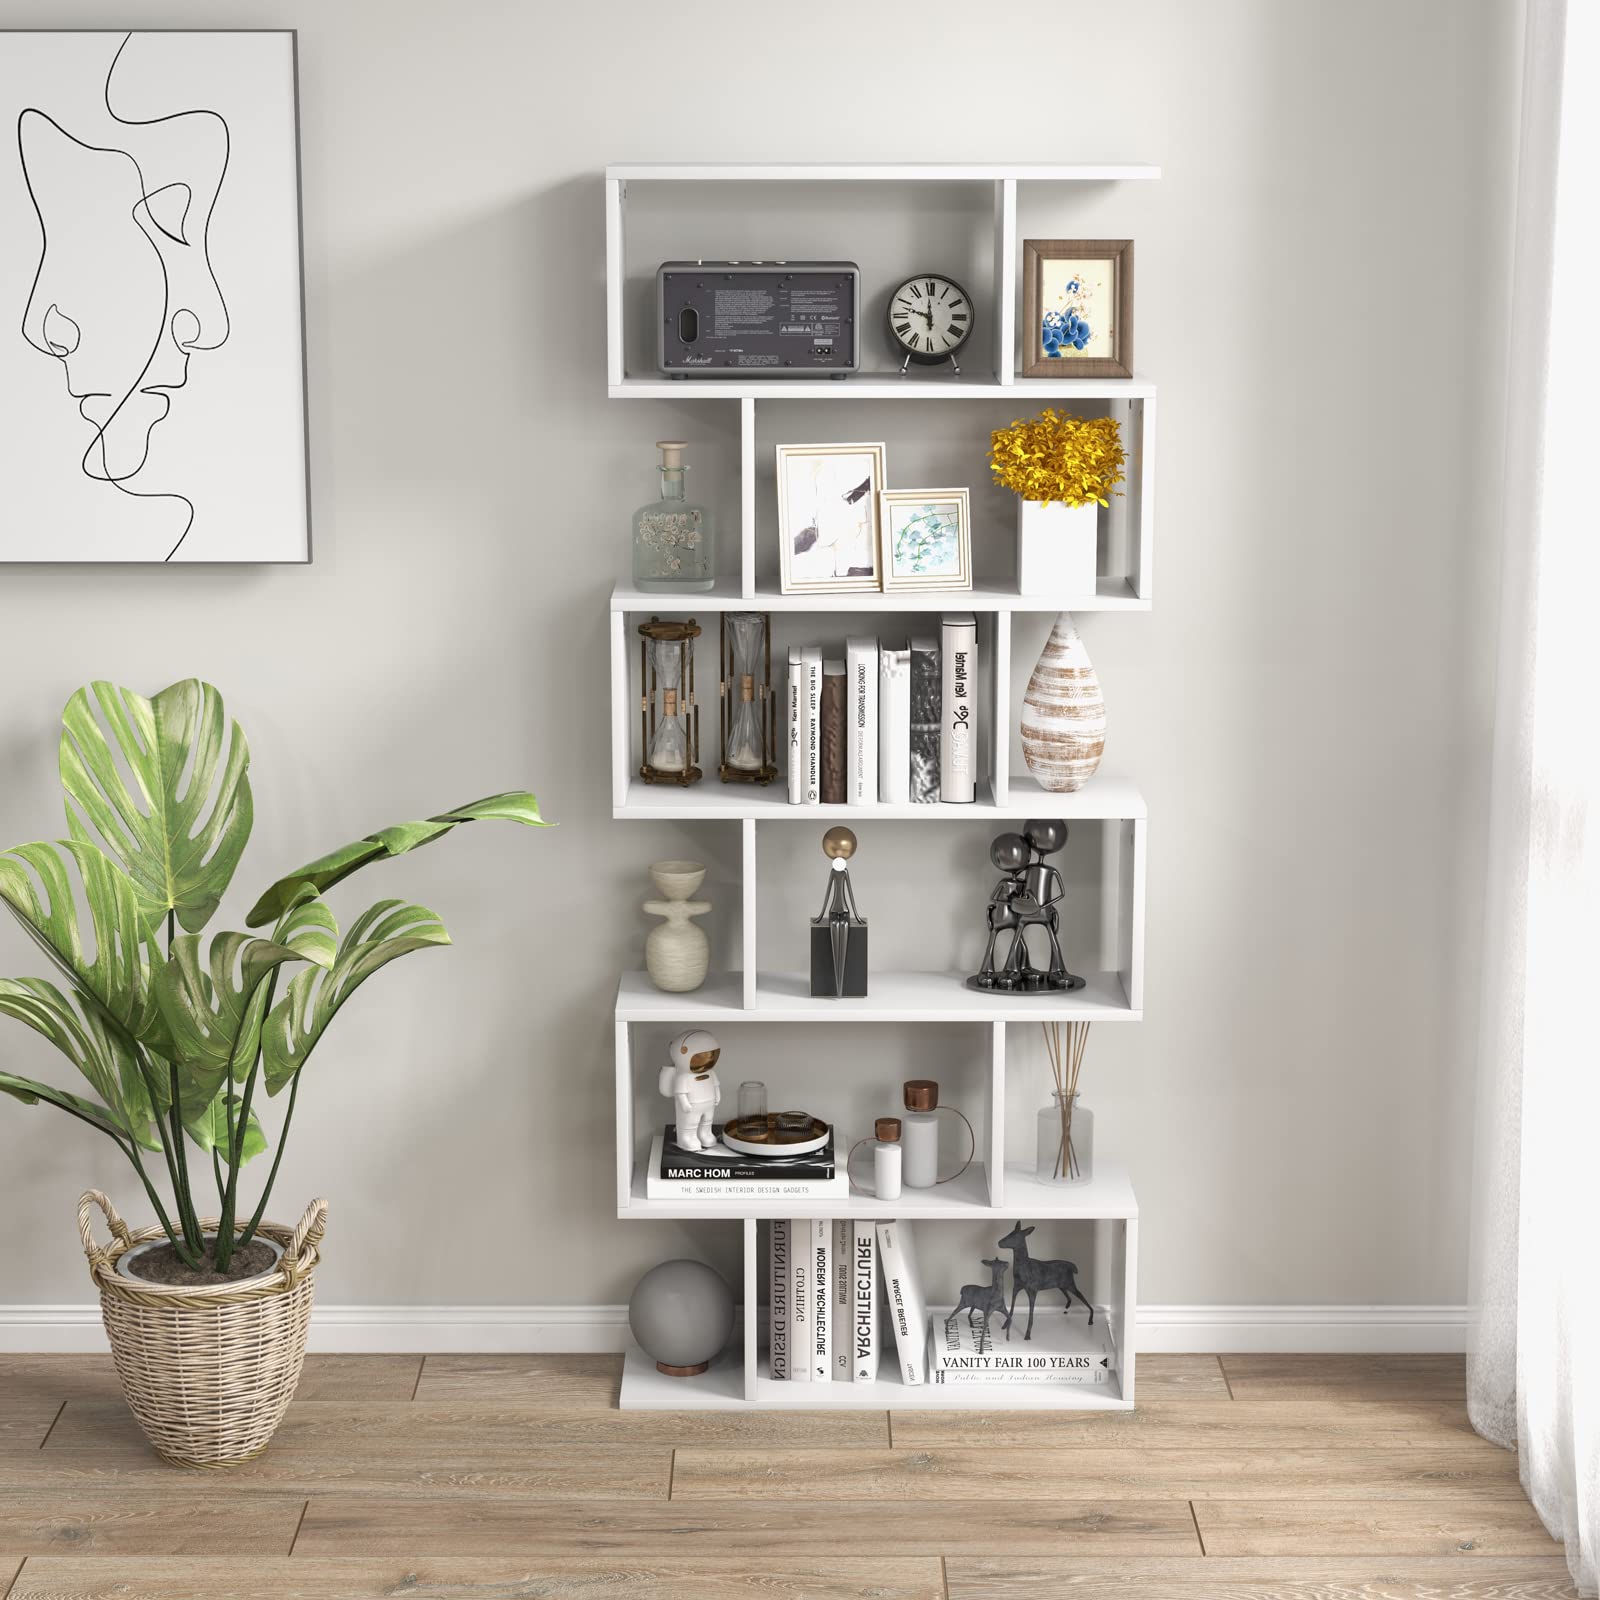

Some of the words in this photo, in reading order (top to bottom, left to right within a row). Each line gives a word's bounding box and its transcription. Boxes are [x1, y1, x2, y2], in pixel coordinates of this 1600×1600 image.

[668, 1168, 702, 1178] MARC
[704, 1168, 731, 1178] HOM
[681, 1186, 692, 1194] THE
[695, 1186, 722, 1194] SWEDISH
[725, 1186, 755, 1194] INTERIOR
[757, 1186, 780, 1194] DESIGN
[783, 1186, 809, 1194] GADGETS
[942, 1357, 991, 1368] VANITY
[995, 1357, 1023, 1368] FAIR
[1027, 1357, 1046, 1368] 100
[1050, 1357, 1090, 1368] YEARS
[985, 1374, 1004, 1382] and
